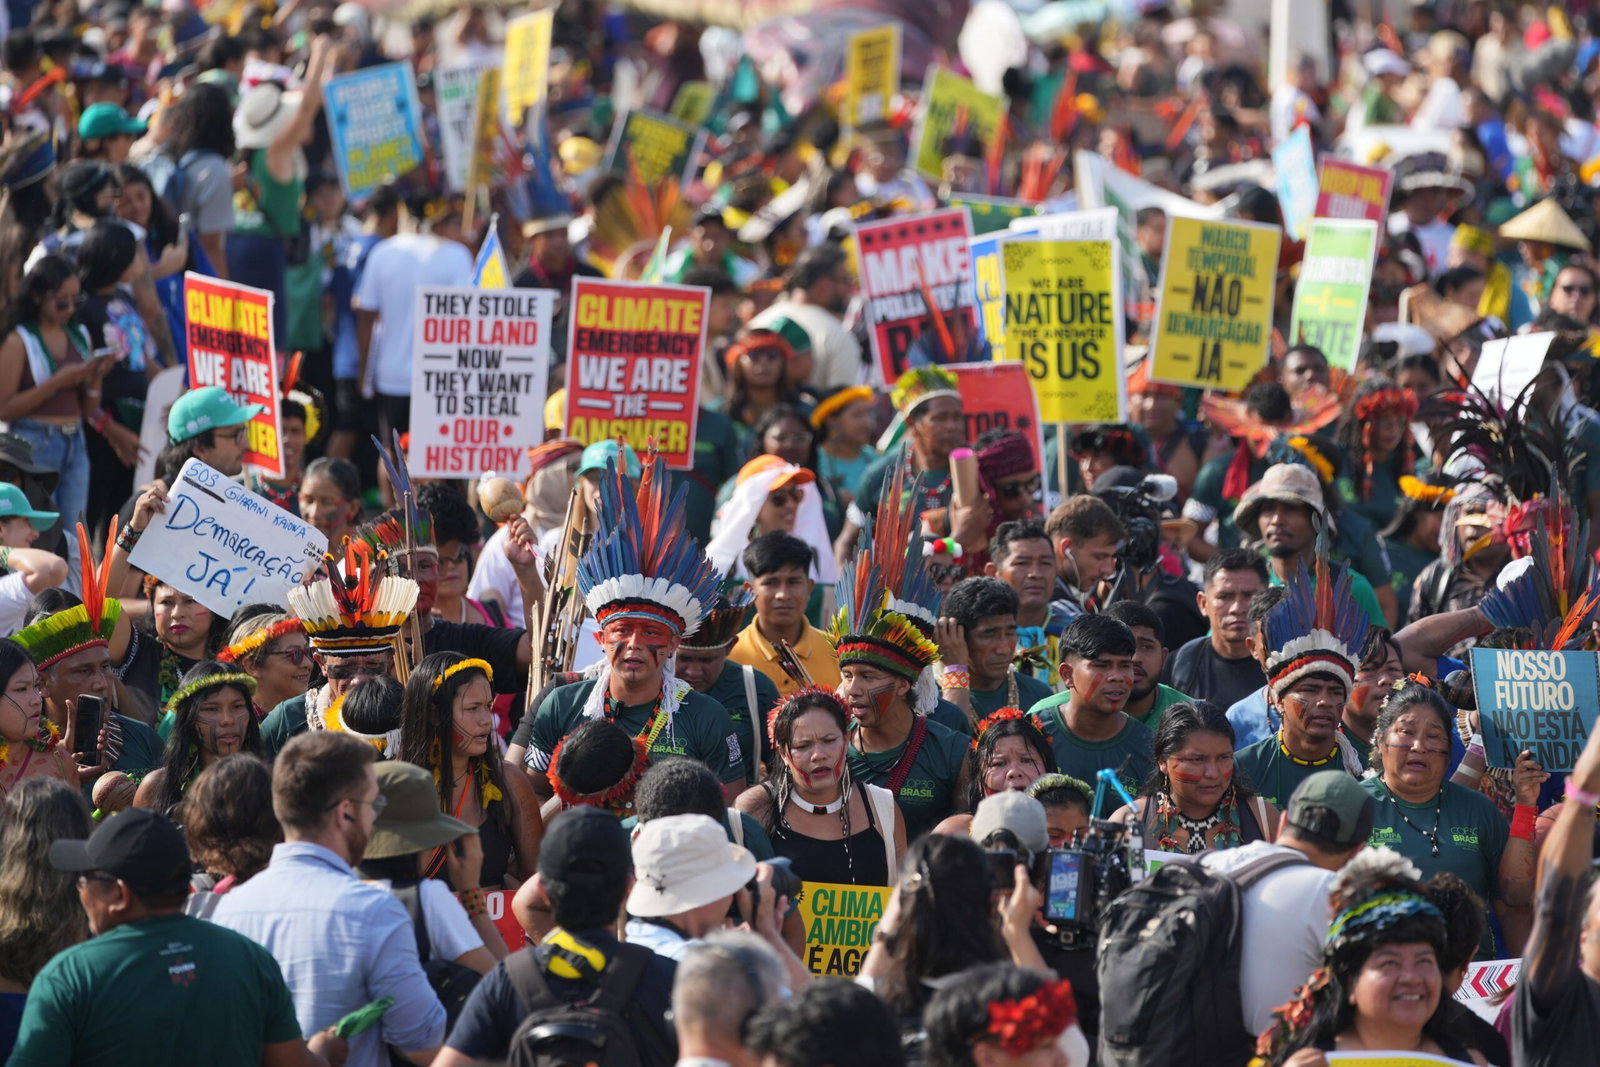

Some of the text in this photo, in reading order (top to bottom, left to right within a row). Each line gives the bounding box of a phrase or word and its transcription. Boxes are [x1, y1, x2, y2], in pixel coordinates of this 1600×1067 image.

[1201, 226, 1250, 251] MARCO
[864, 236, 971, 298] MAKE
[1188, 247, 1257, 279] TEMPORAL
[1031, 278, 1085, 289] WE ARE
[1192, 271, 1242, 318] NÃO
[187, 288, 268, 340] CLIMATE
[424, 294, 538, 317] THEY STOLE
[577, 293, 702, 335] CLIMATE
[1005, 292, 1111, 325] NATURE
[189, 325, 269, 361] EMERGENCY
[424, 318, 538, 345] OUR LAND
[576, 328, 698, 356] EMERGENCY
[193, 349, 271, 398] WE ARE
[457, 349, 502, 369] NOW
[578, 354, 690, 394] WE ARE
[1020, 341, 1101, 380] IS US
[424, 371, 534, 393] THEY WANT
[434, 394, 520, 416] TO STEAL
[612, 394, 648, 417] THE
[454, 419, 499, 444] OUR
[570, 416, 689, 453] ANSWER
[425, 446, 522, 472] HISTORY
[186, 463, 220, 487] SOS
[224, 486, 269, 517] GUARANI
[1496, 651, 1566, 680] NOSSO
[1495, 680, 1574, 710] FUTURO
[1492, 707, 1587, 740] NÃO ESTÁ
[652, 745, 687, 755] BRASIL
[900, 787, 934, 798] BRASIL
[812, 888, 883, 919] CLIMA
[807, 944, 824, 975] É
